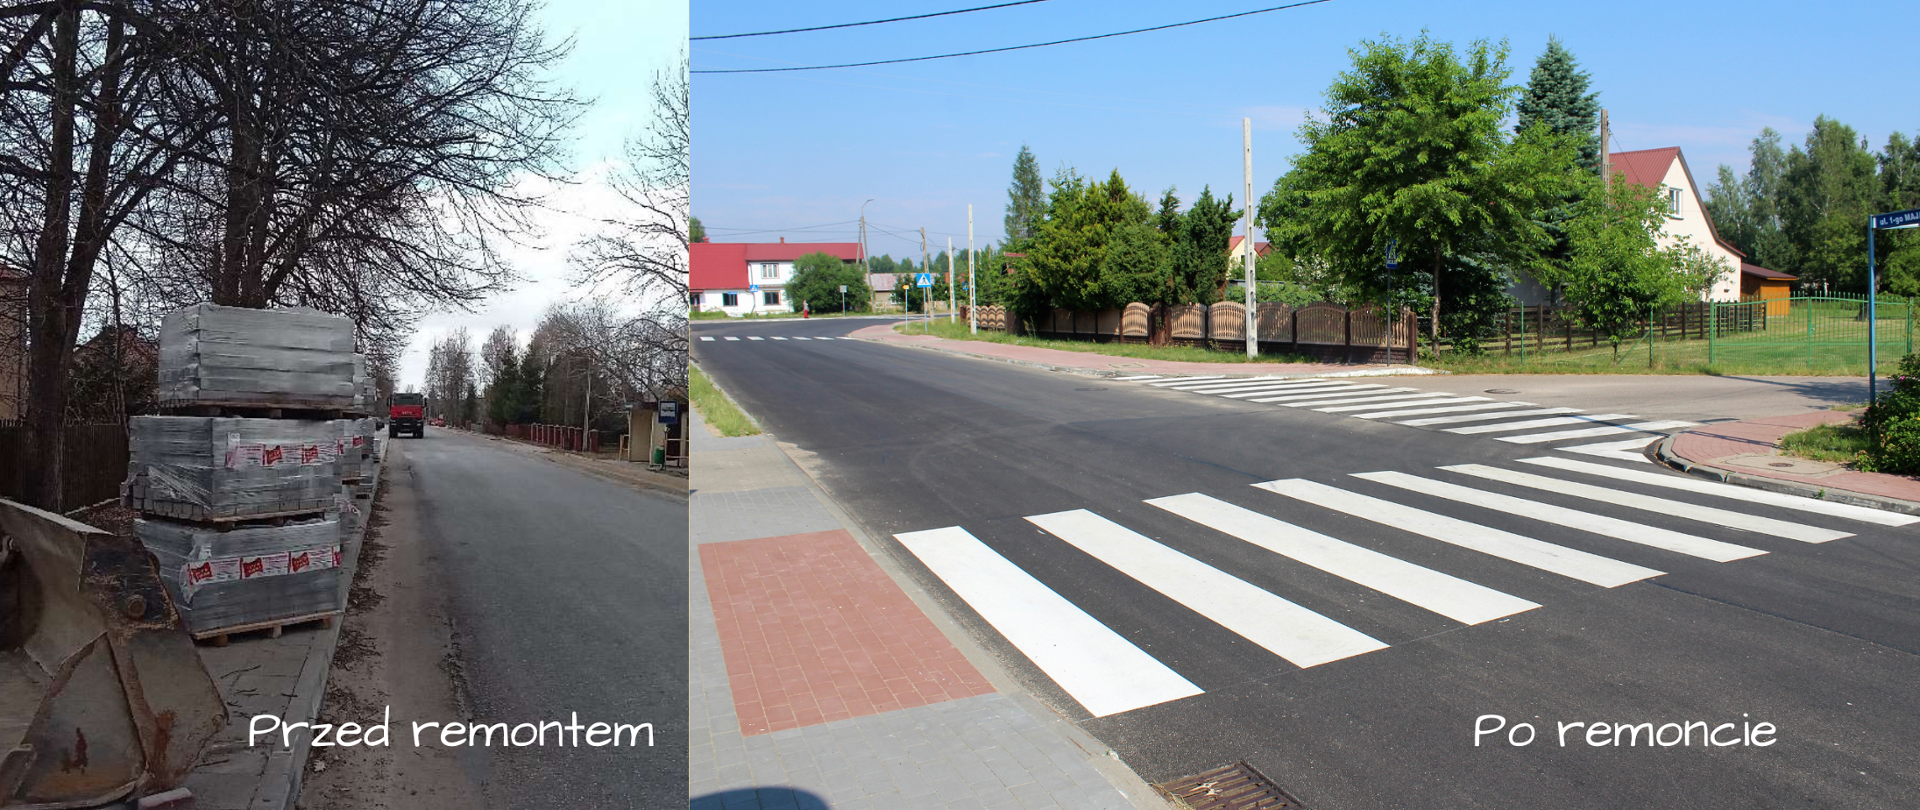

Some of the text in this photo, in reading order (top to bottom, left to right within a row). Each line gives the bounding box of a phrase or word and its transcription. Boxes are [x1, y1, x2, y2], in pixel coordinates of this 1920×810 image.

[1880, 211, 1920, 226] ul. 1-go MAJ
